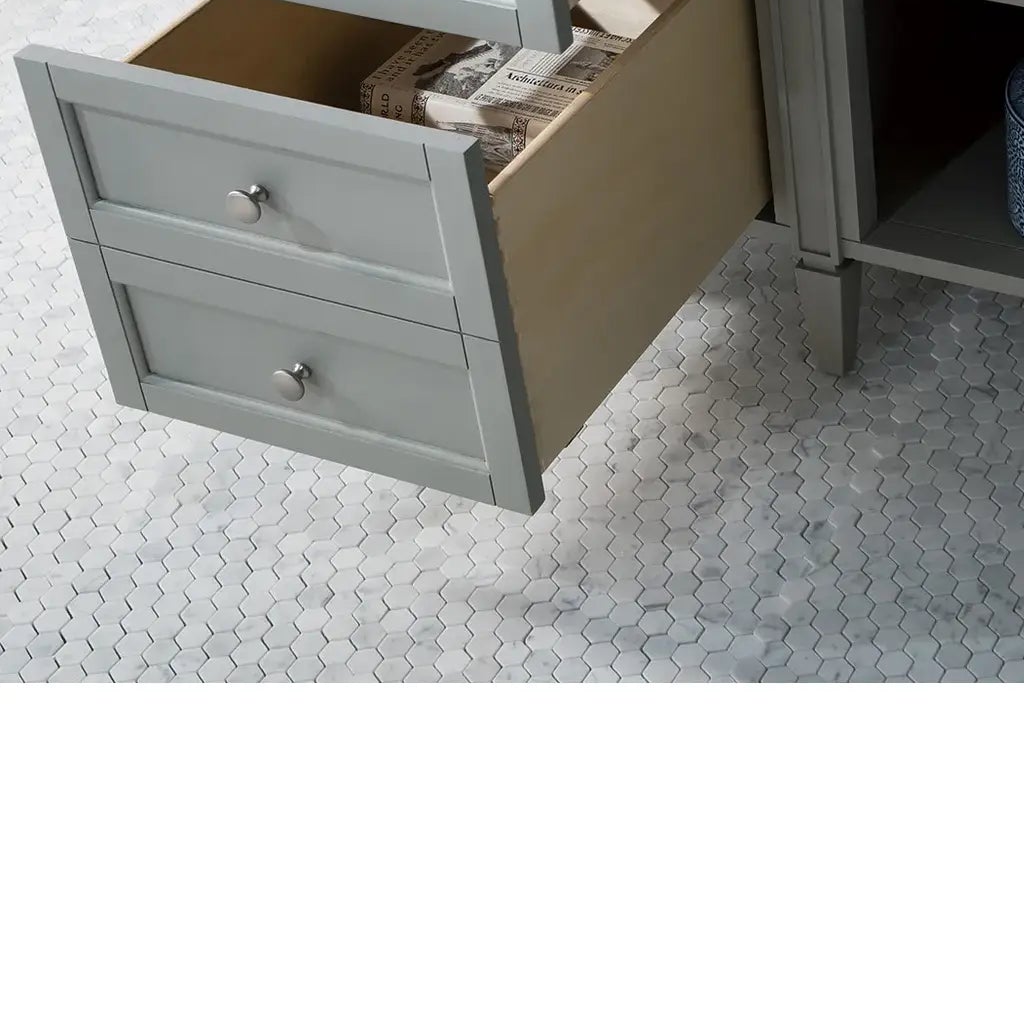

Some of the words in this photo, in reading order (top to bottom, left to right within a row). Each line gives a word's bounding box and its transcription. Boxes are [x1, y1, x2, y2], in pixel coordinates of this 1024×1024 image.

[377, 55, 407, 76] have
[403, 36, 429, 55] seen
[387, 65, 409, 82] and
[381, 93, 390, 117] RLD
